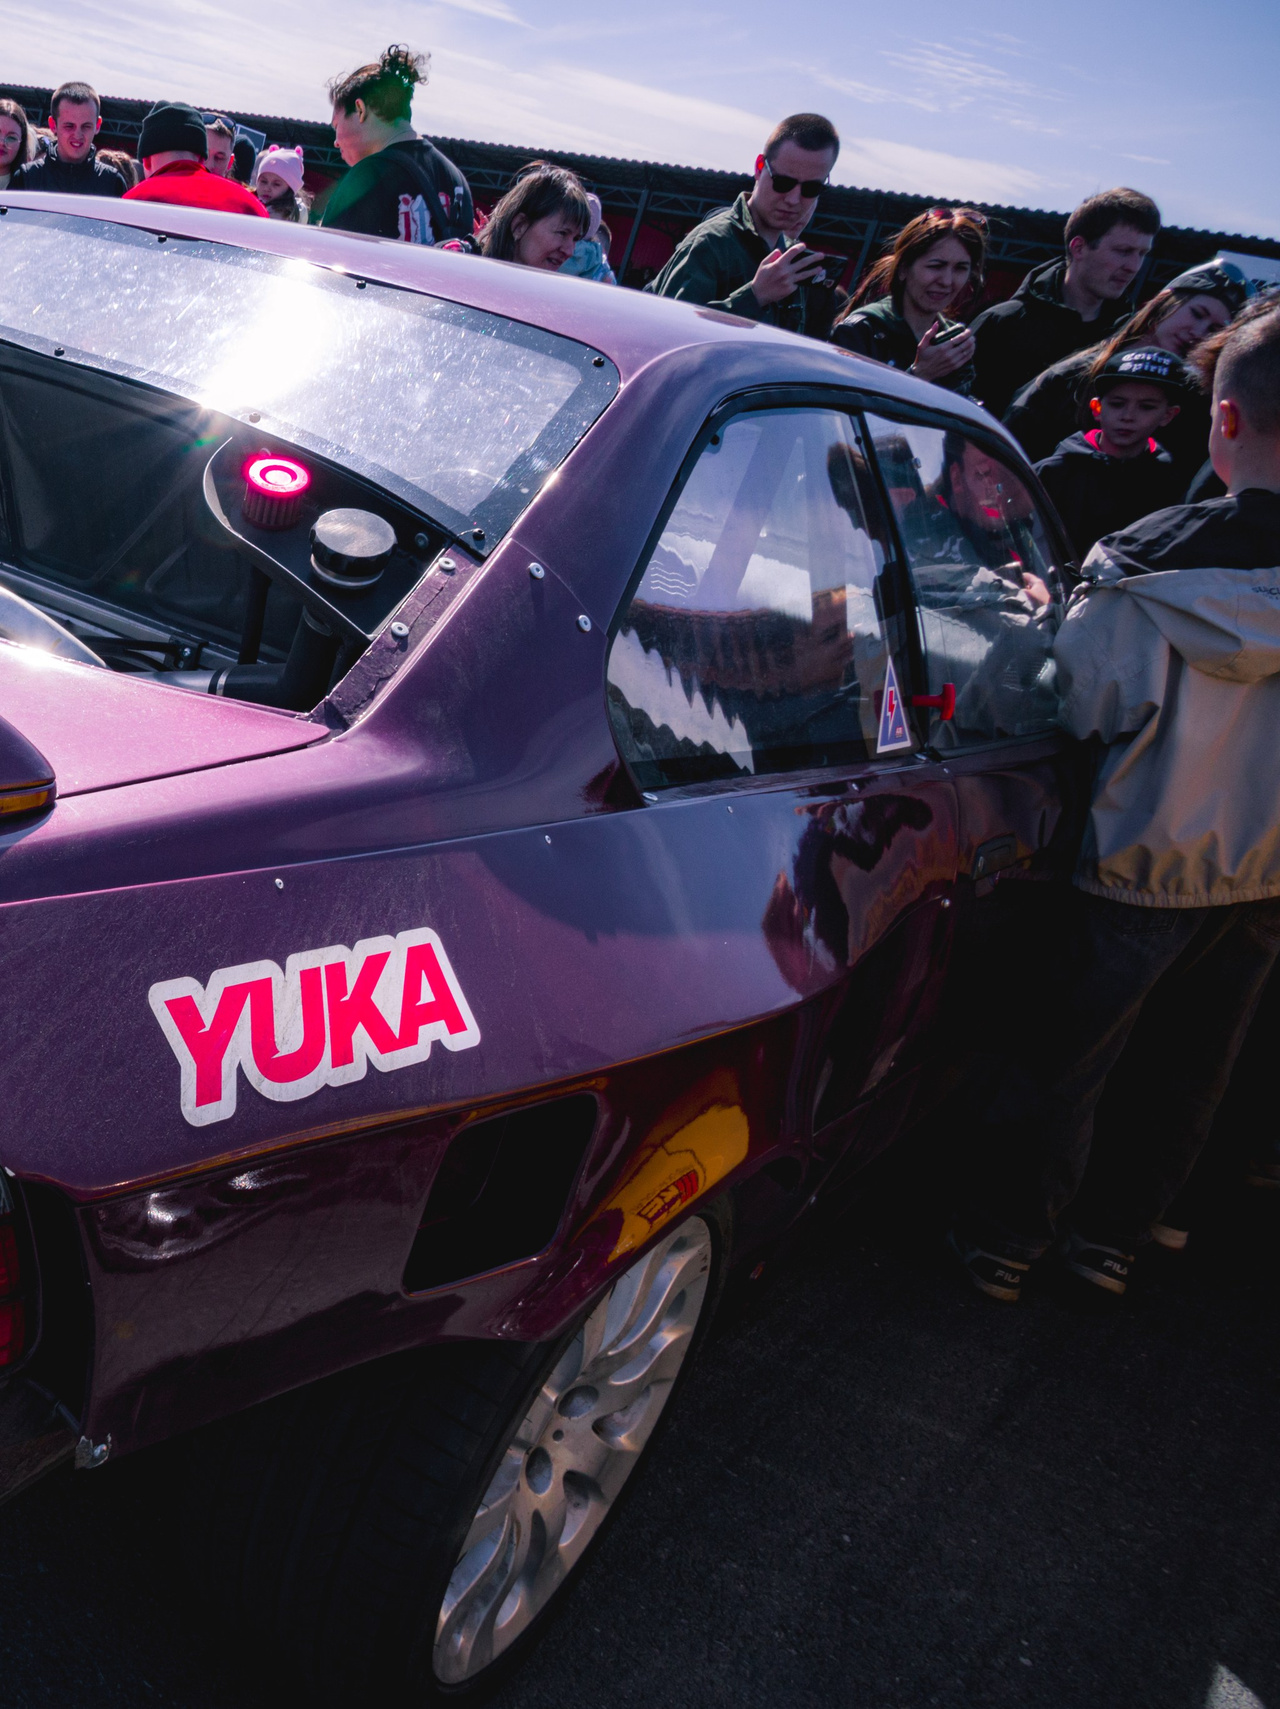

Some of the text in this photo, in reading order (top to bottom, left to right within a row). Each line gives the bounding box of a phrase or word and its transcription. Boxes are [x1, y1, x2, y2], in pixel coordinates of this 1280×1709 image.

[160, 938, 472, 1112] YUKA
[994, 1268, 1021, 1284] FILA
[1102, 1258, 1129, 1276] FILA
